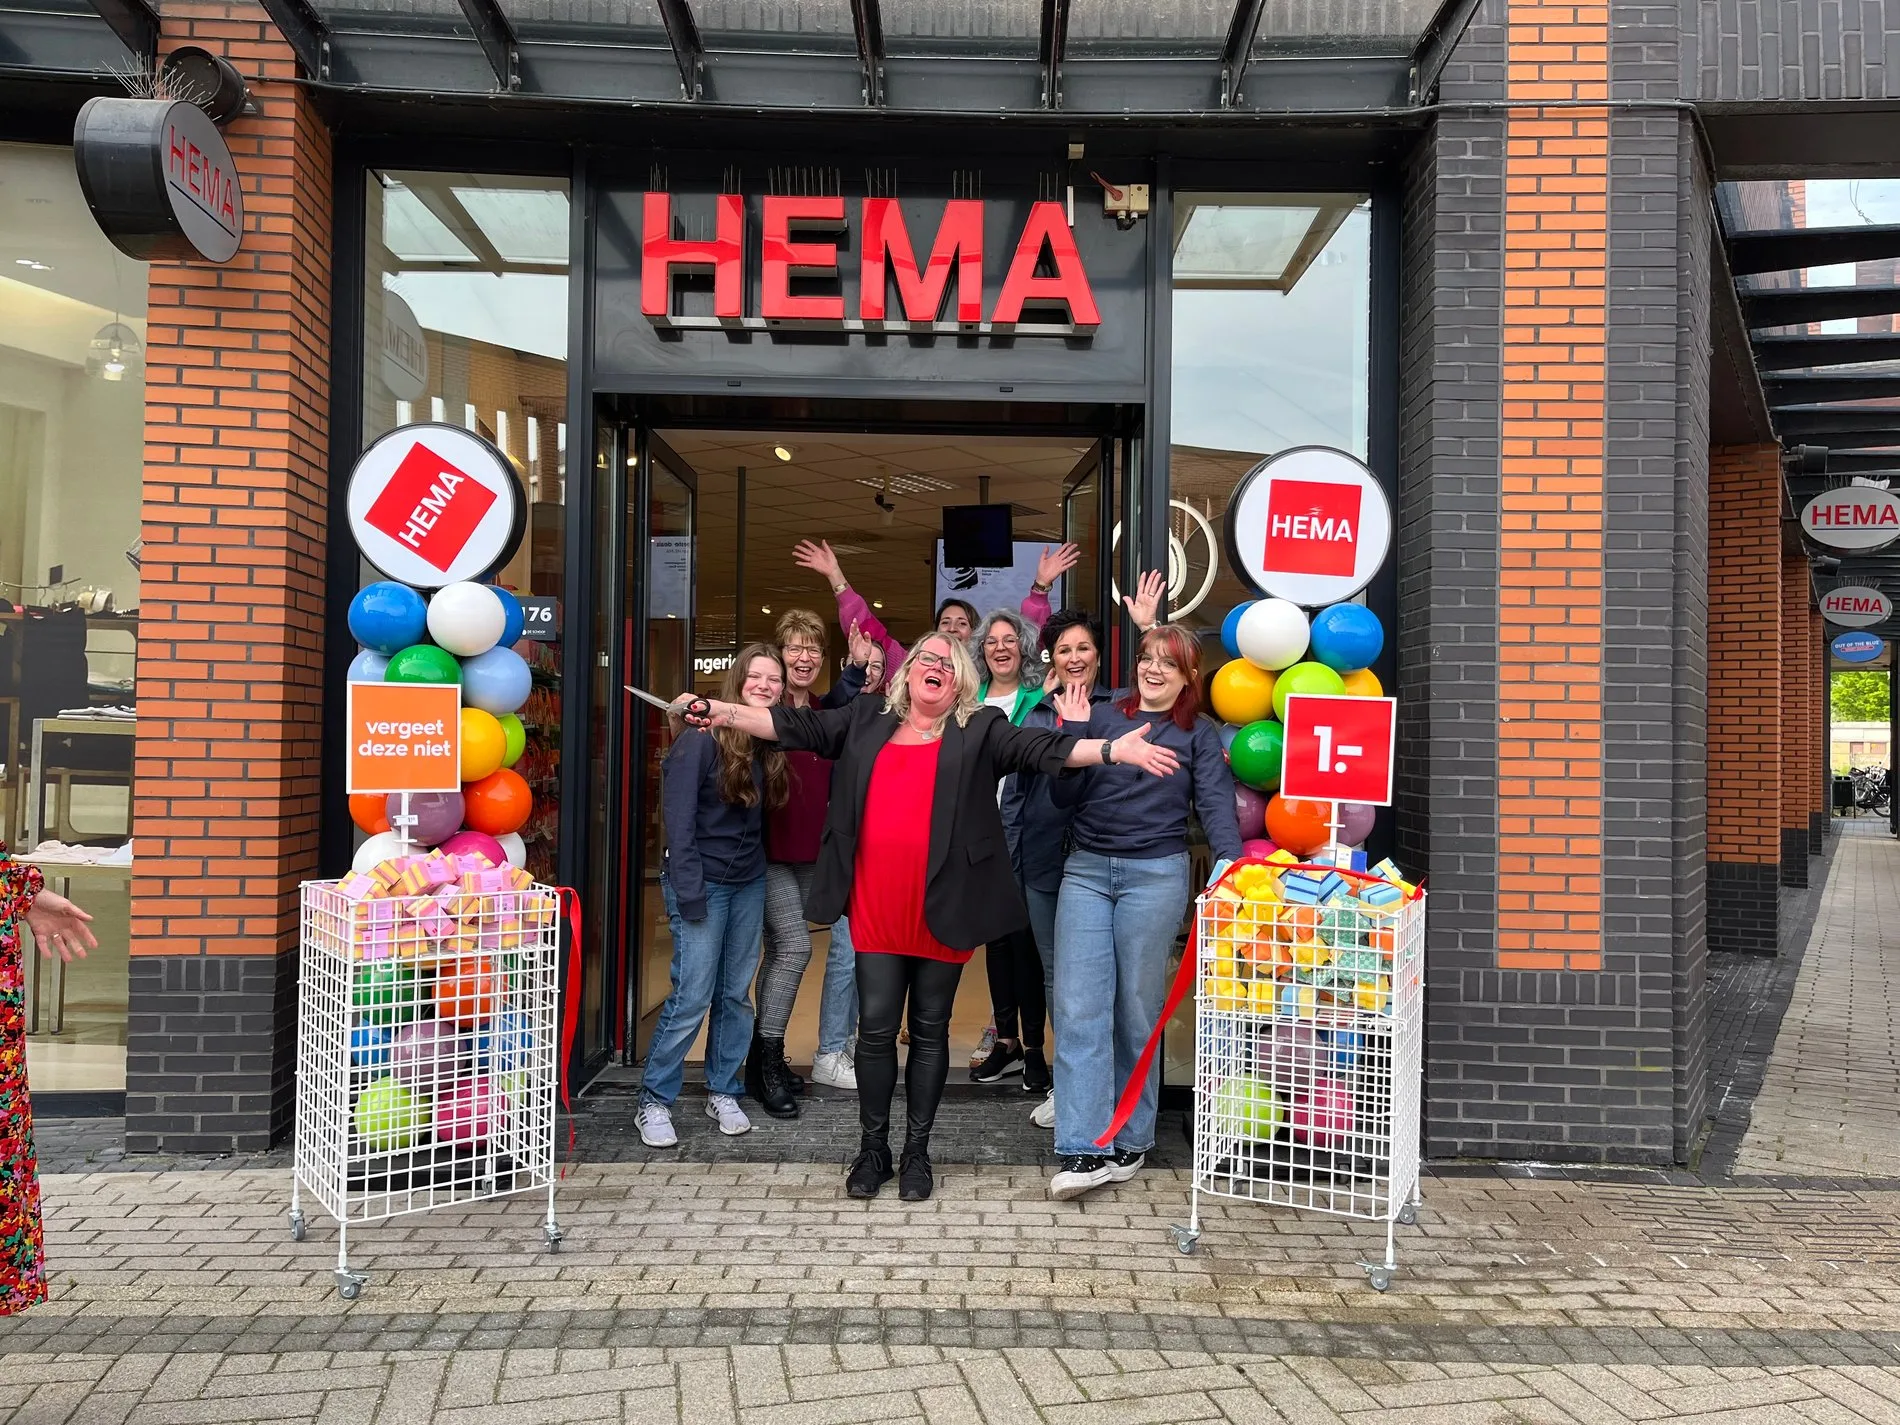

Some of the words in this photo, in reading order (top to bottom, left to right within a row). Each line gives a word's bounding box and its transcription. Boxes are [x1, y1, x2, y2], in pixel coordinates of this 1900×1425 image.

[170, 124, 236, 227] HEMA
[641, 191, 1101, 324] HEMA
[398, 471, 465, 548] HEMA
[1811, 504, 1899, 525] HEMA
[1271, 514, 1353, 543] HEMA
[1826, 596, 1883, 613] HEMA
[694, 653, 736, 674] ngeri
[366, 719, 444, 740] vergeet
[358, 739, 409, 757] deze
[413, 739, 452, 757] niet
